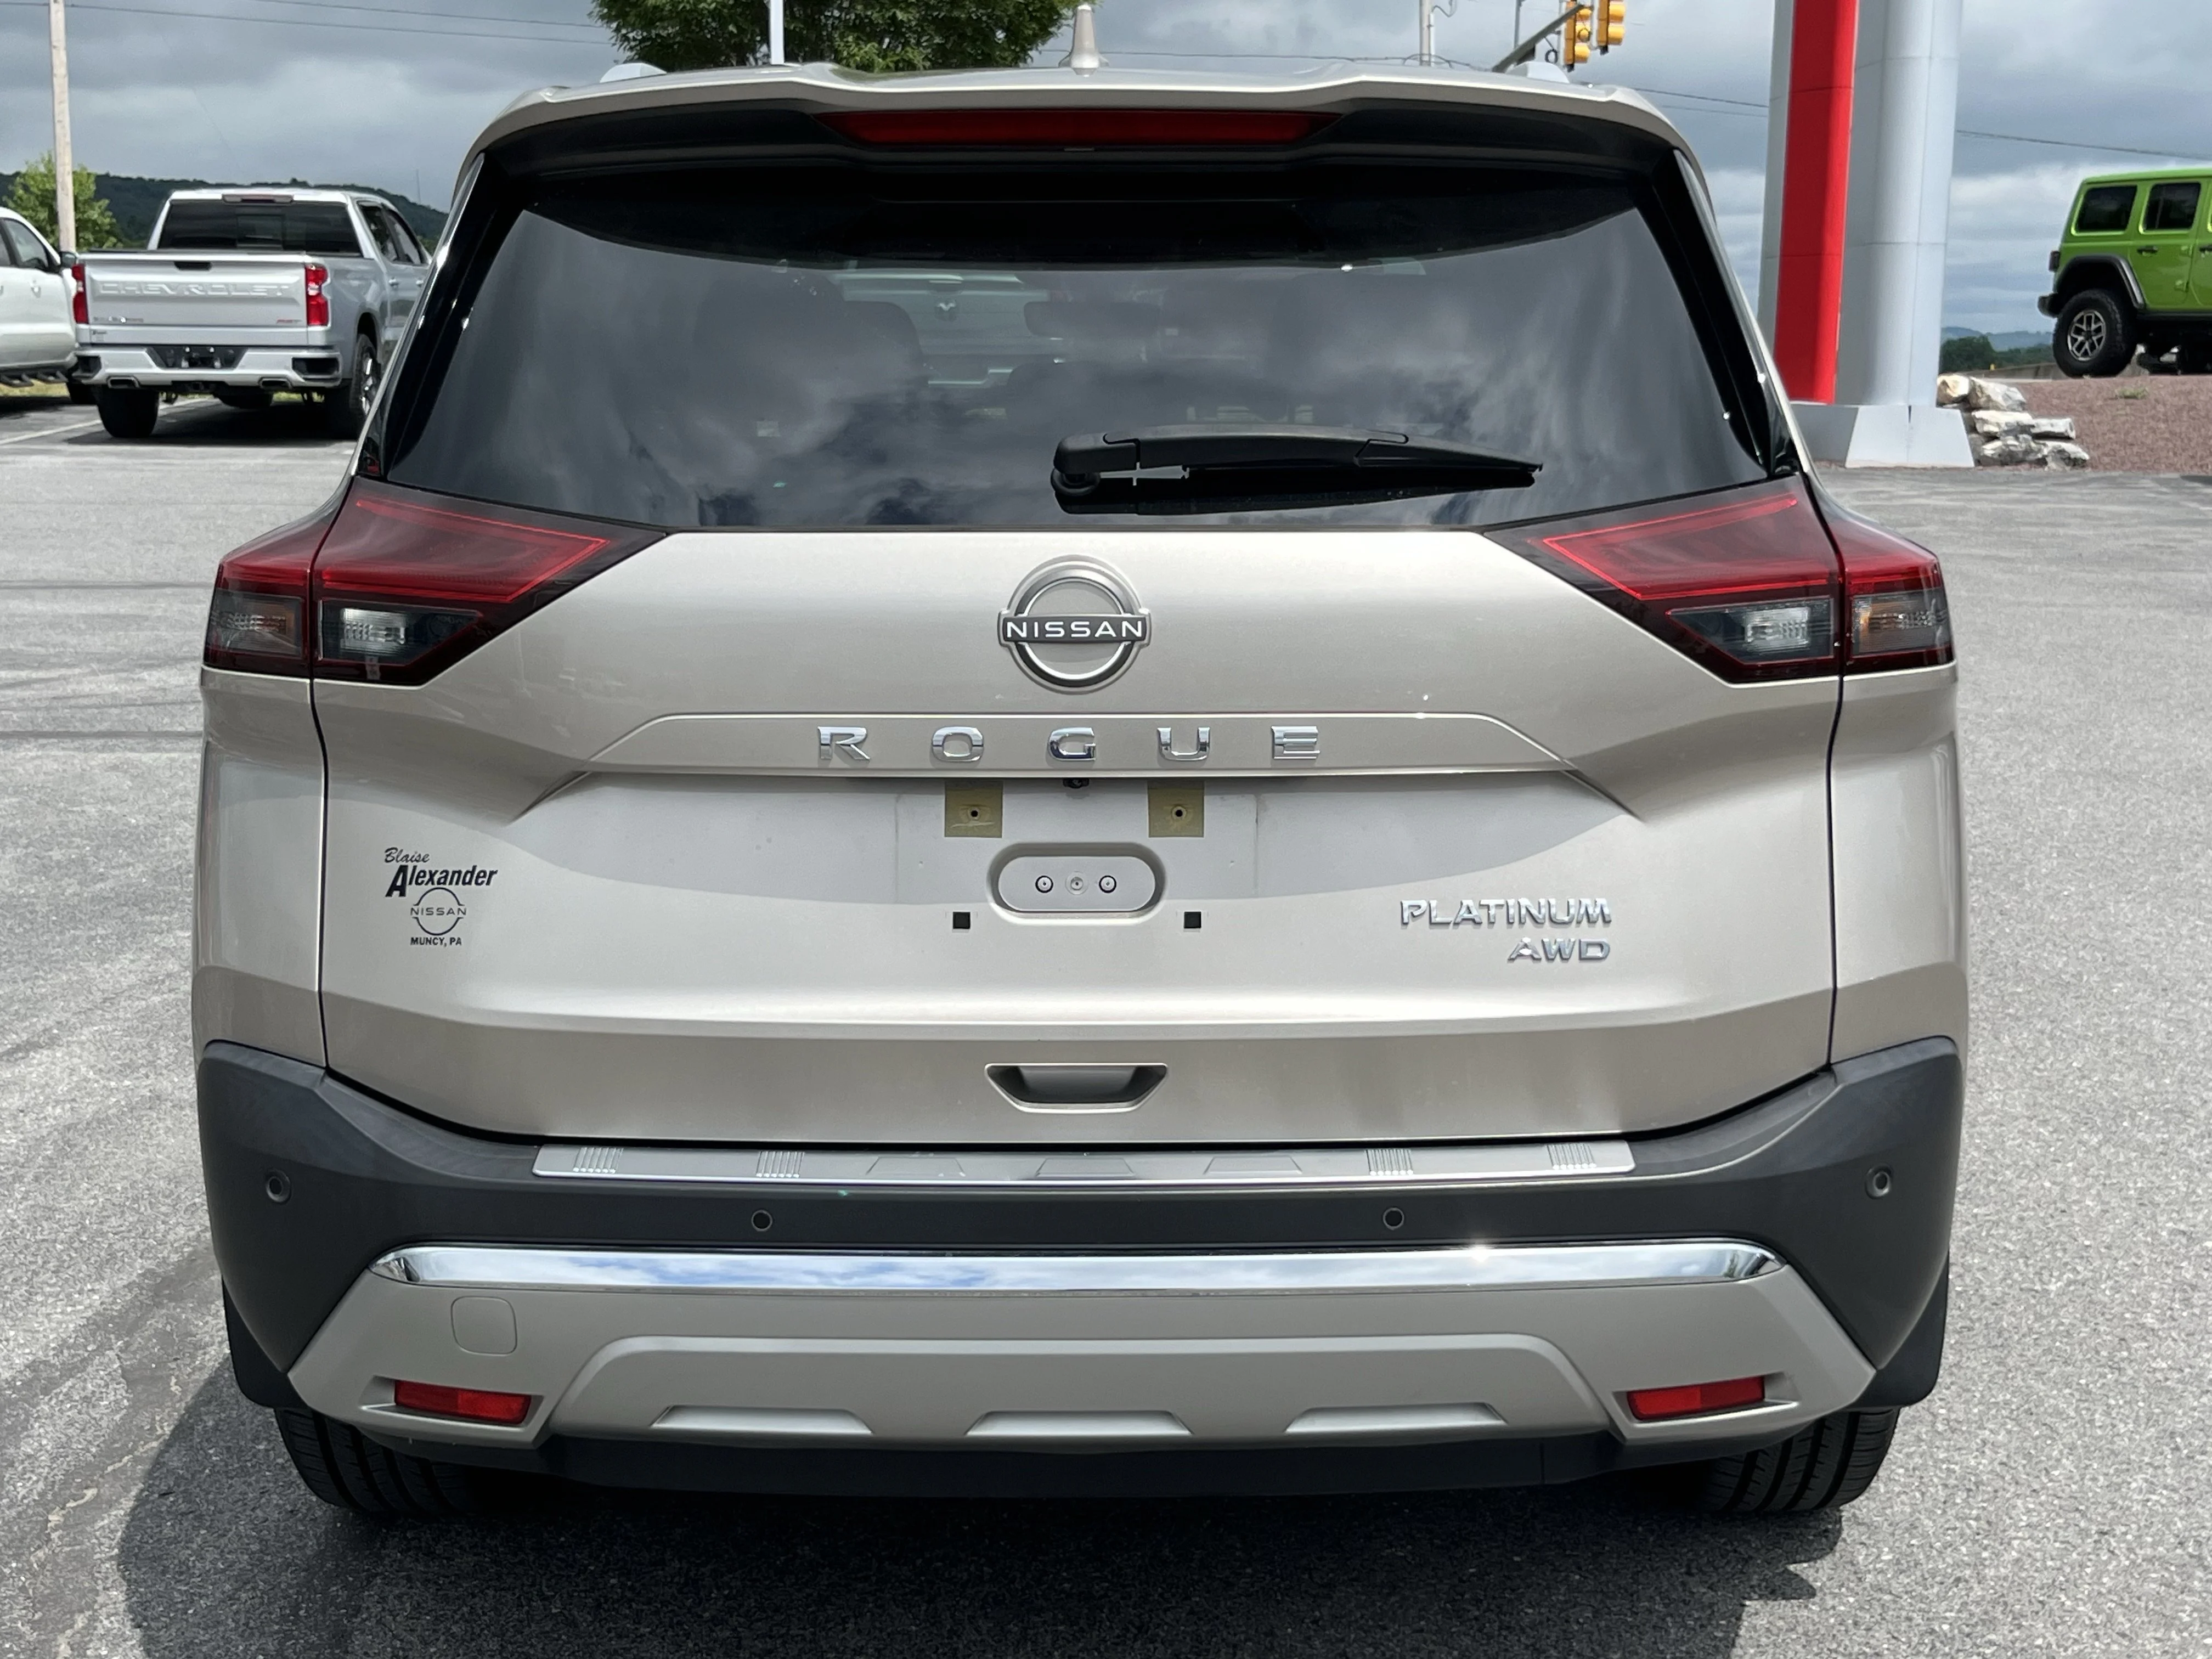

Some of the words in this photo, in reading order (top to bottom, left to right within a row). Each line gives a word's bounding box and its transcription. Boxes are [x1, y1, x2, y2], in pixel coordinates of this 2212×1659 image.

[1006, 619, 1143, 639] NISSAN
[817, 725, 1321, 762] ROGUE
[385, 847, 430, 863] Blaise
[385, 865, 498, 897] Alexander
[410, 907, 466, 916] NISSAN
[1401, 898, 1612, 926] PLATINUM
[410, 937, 447, 947] MUNCY,
[449, 937, 462, 945] PA
[1507, 937, 1611, 961] AWD
